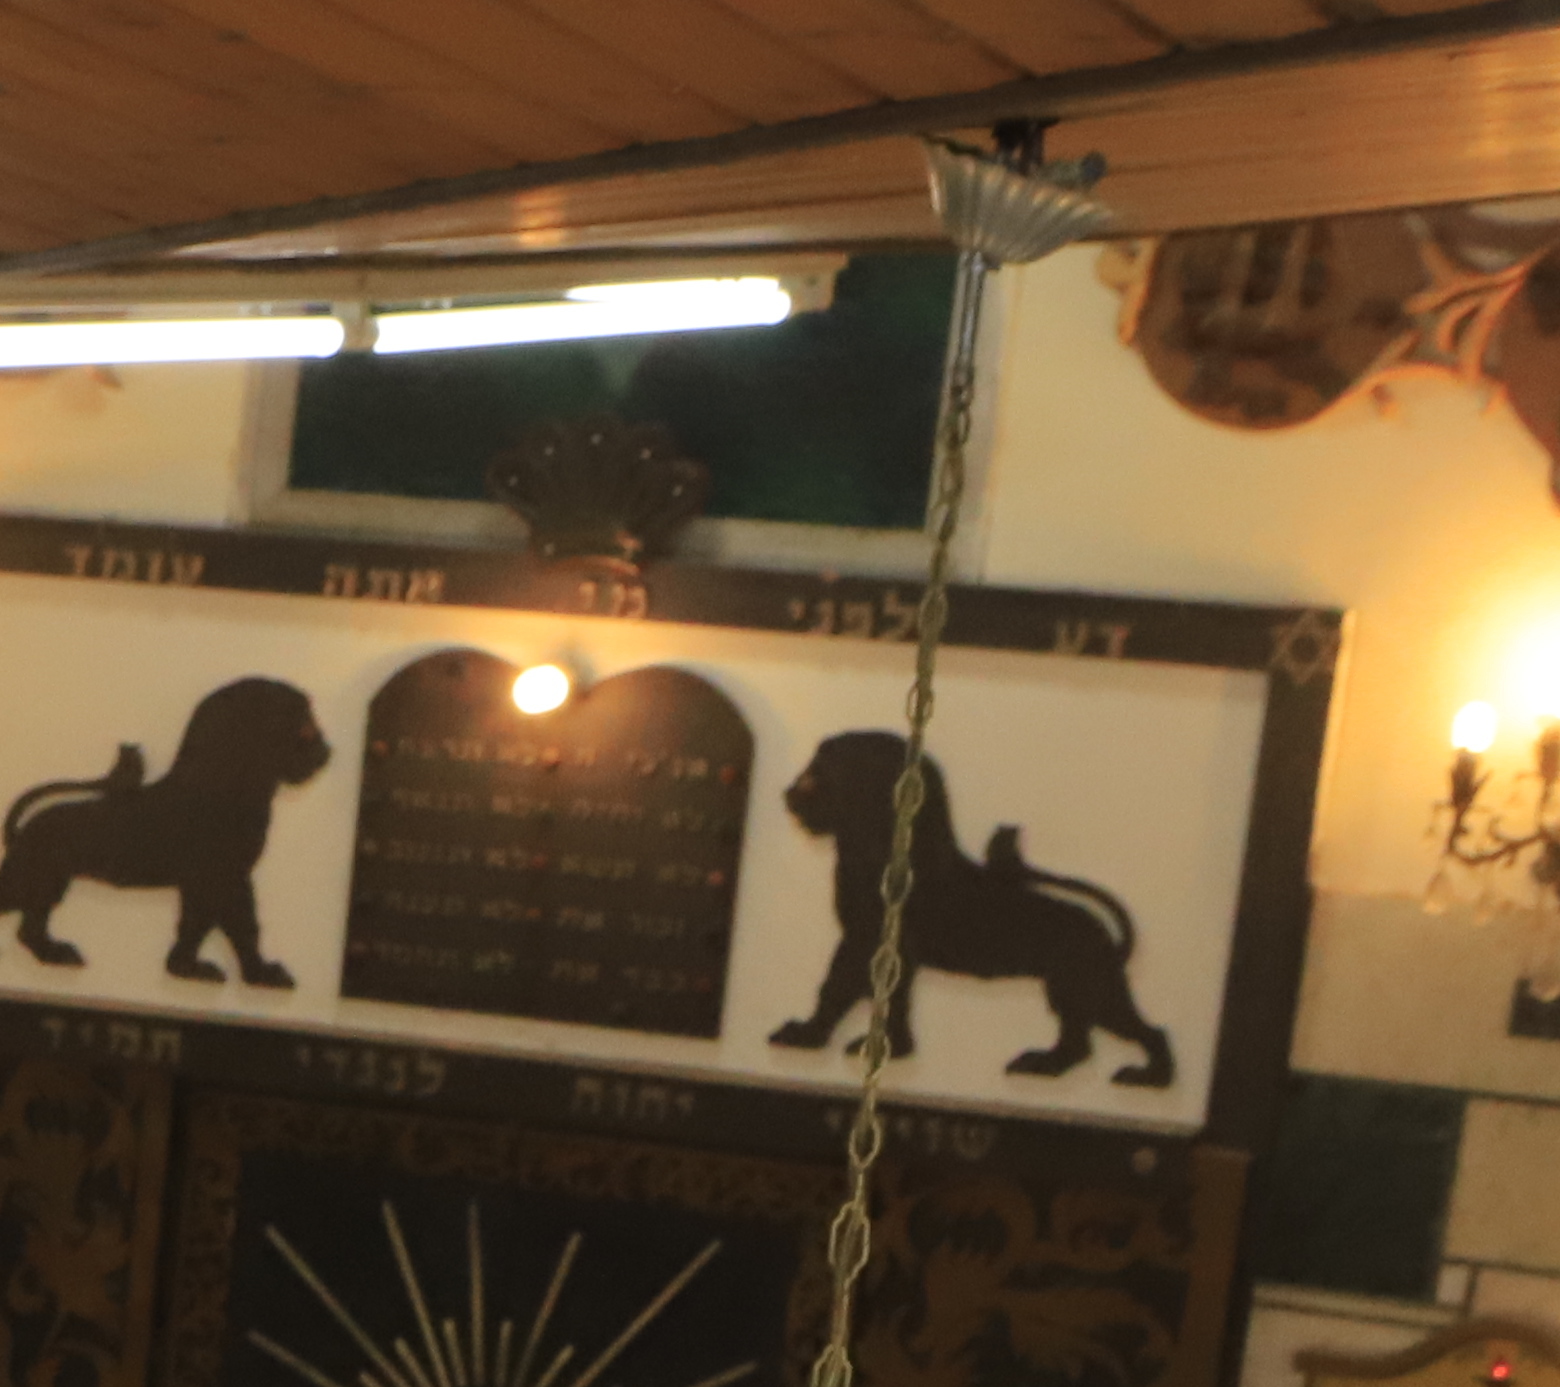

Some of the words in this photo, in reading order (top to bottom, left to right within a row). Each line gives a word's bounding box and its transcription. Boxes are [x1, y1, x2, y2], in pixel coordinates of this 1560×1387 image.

[64, 544, 205, 584] עומד
[323, 560, 446, 604] אתה
[786, 586, 922, 641] לפני
[1054, 619, 1131, 658] דע
[40, 1014, 183, 1066] תמיד
[294, 1044, 447, 1098] לנגדי
[823, 1107, 999, 1161] שויי
